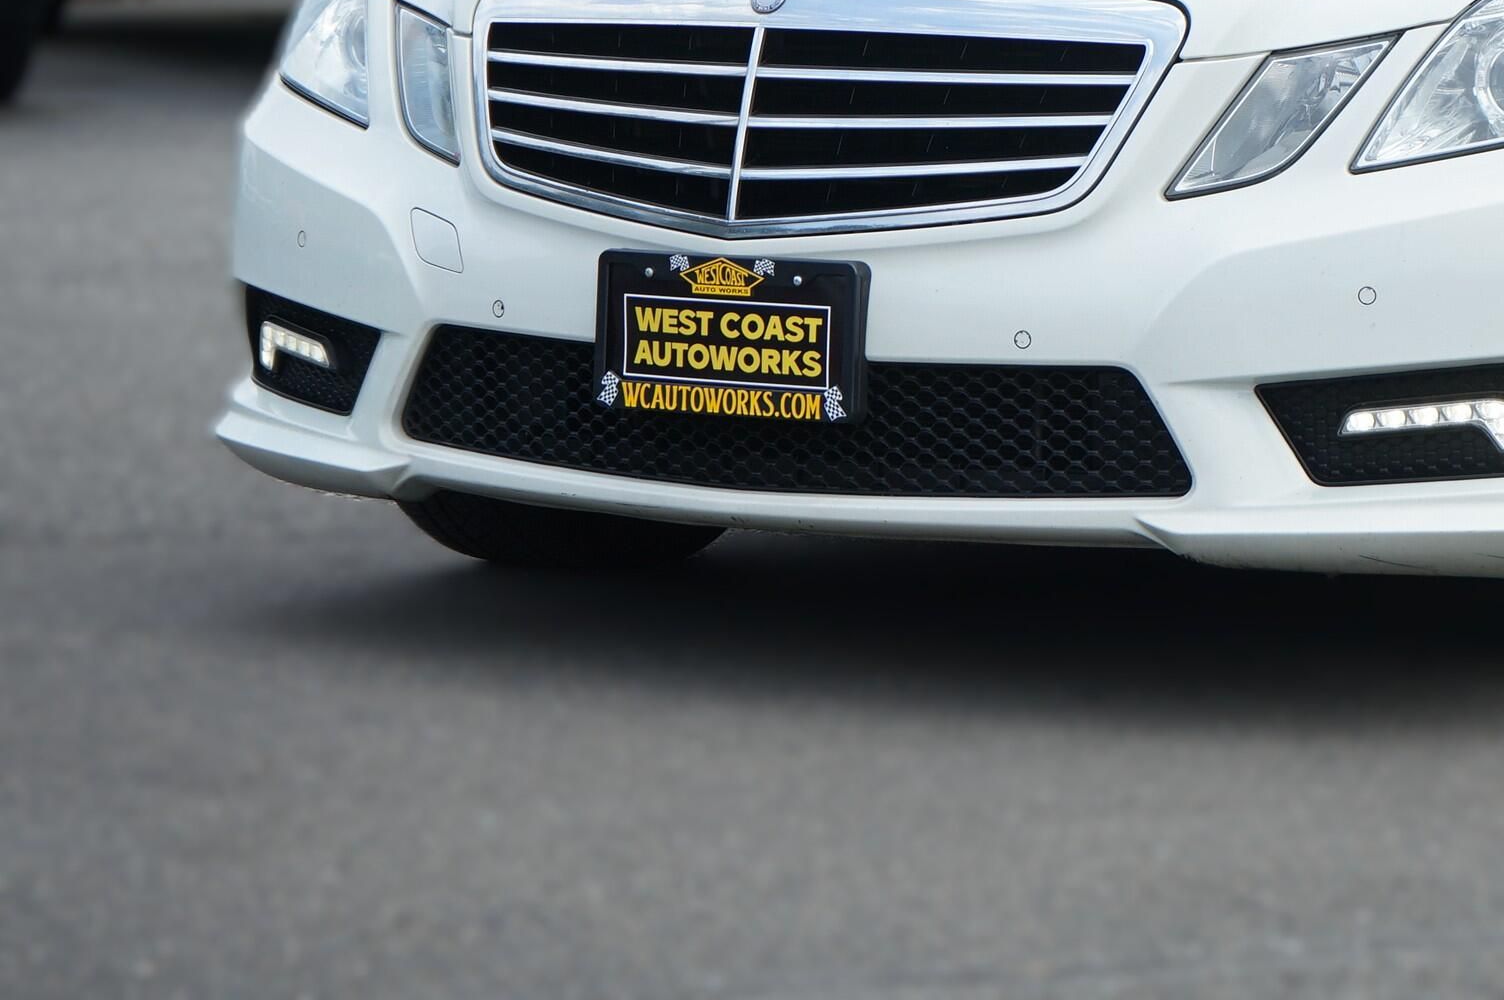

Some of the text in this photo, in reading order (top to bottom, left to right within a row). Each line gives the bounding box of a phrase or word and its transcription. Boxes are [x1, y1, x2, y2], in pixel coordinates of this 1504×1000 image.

[718, 287, 749, 295] WORKS
[635, 306, 823, 343] WEST COAST
[634, 340, 822, 377] AUTOWORKS
[621, 381, 821, 420] WCAUTOWORKS.COM
